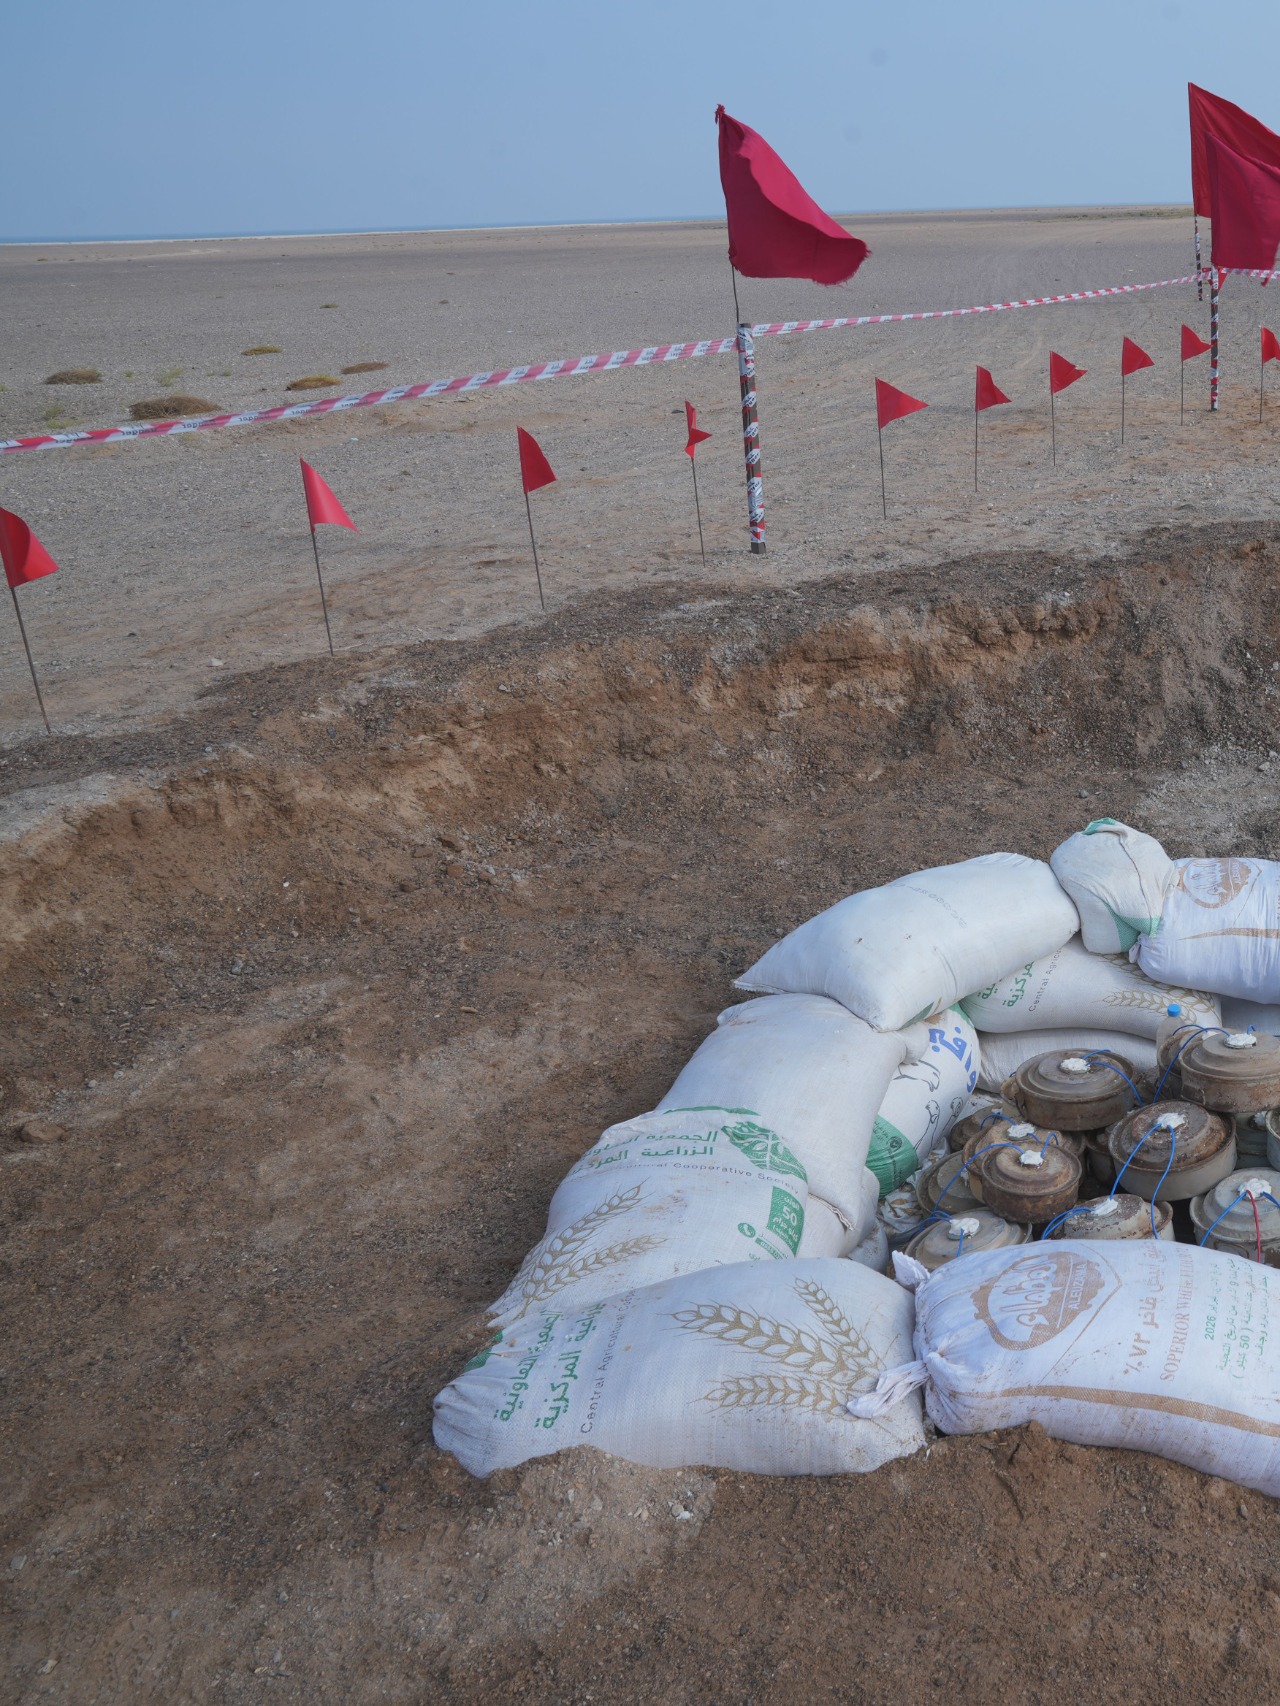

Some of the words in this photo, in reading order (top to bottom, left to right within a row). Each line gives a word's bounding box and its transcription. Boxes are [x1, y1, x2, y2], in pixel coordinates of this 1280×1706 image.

[1028, 978, 1048, 1012] Central
[641, 1146, 714, 1157] الزراعية
[673, 1162, 752, 1177] Cooperative
[782, 1206, 798, 1226] 50
[1070, 1263, 1087, 1310] ALEUZAMA
[1138, 1296, 1159, 1329] فاخر
[1204, 1315, 1216, 1341] 2026
[1160, 1311, 1190, 1382] SOPERIOR
[1239, 1335, 1250, 1350] 50
[494, 1354, 540, 1422] التعاونية
[534, 1350, 582, 1429] المركزية
[580, 1378, 605, 1434] Central
[598, 1314, 625, 1371] Agricultural
